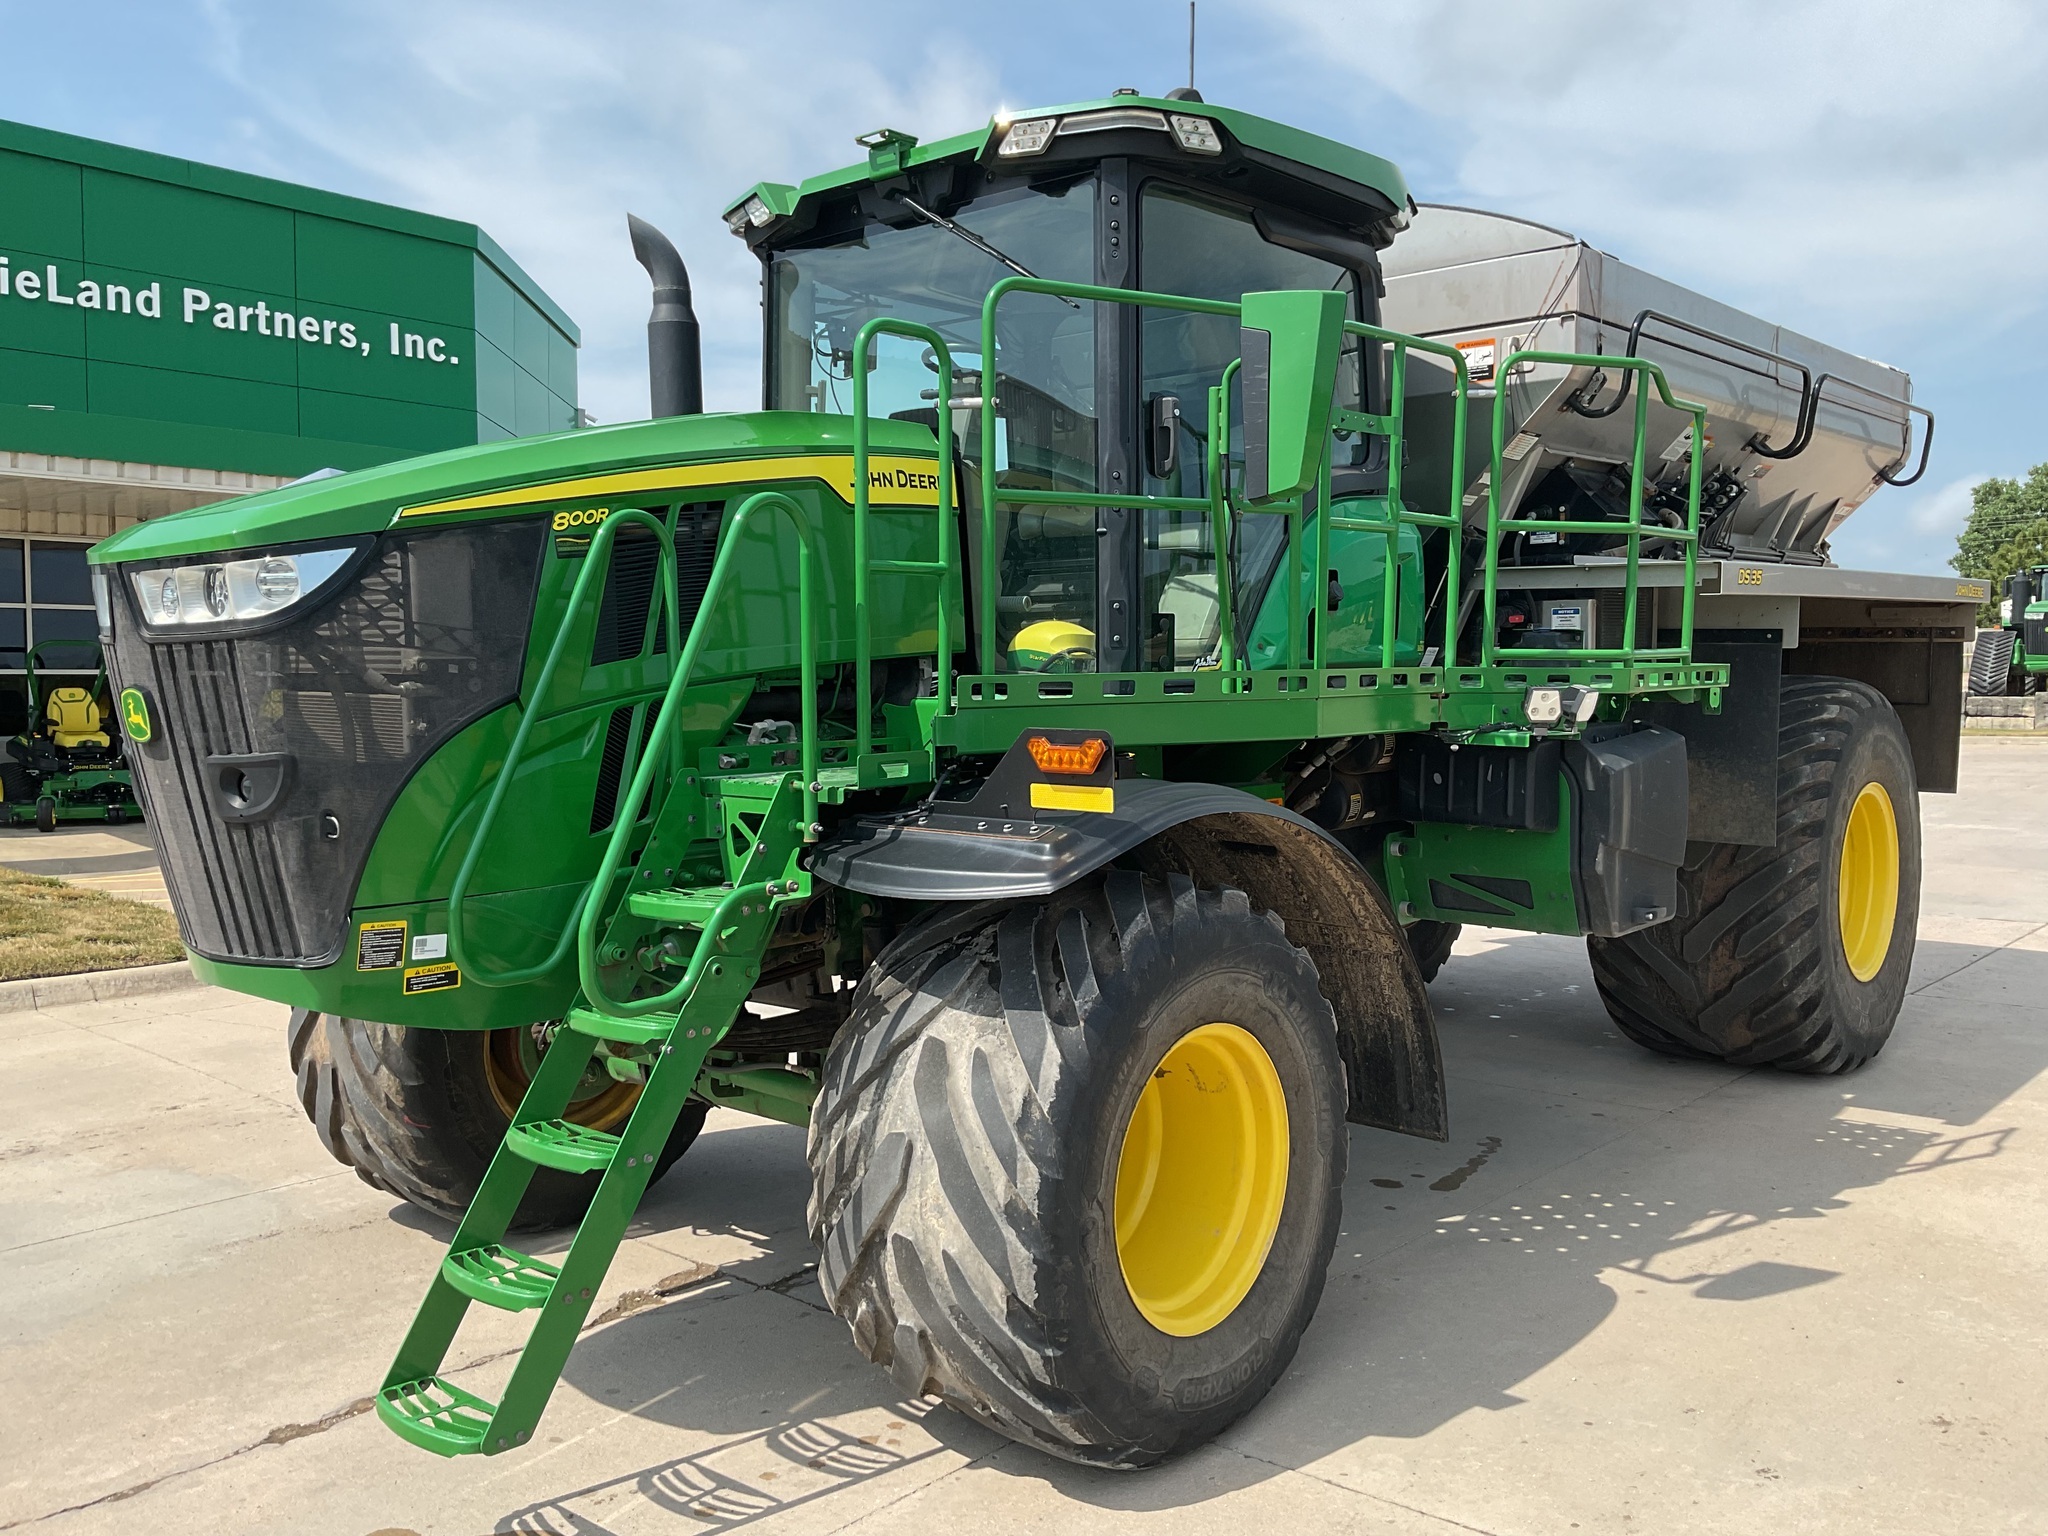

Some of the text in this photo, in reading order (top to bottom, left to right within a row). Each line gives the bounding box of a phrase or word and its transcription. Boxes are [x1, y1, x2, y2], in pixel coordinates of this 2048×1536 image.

[183, 287, 370, 357] Partners,
[390, 322, 459, 365] Inc.
[896, 469, 939, 490] DEER
[552, 507, 609, 531] 800R
[1738, 568, 1763, 585] DS 35
[421, 964, 453, 975] CAUTION
